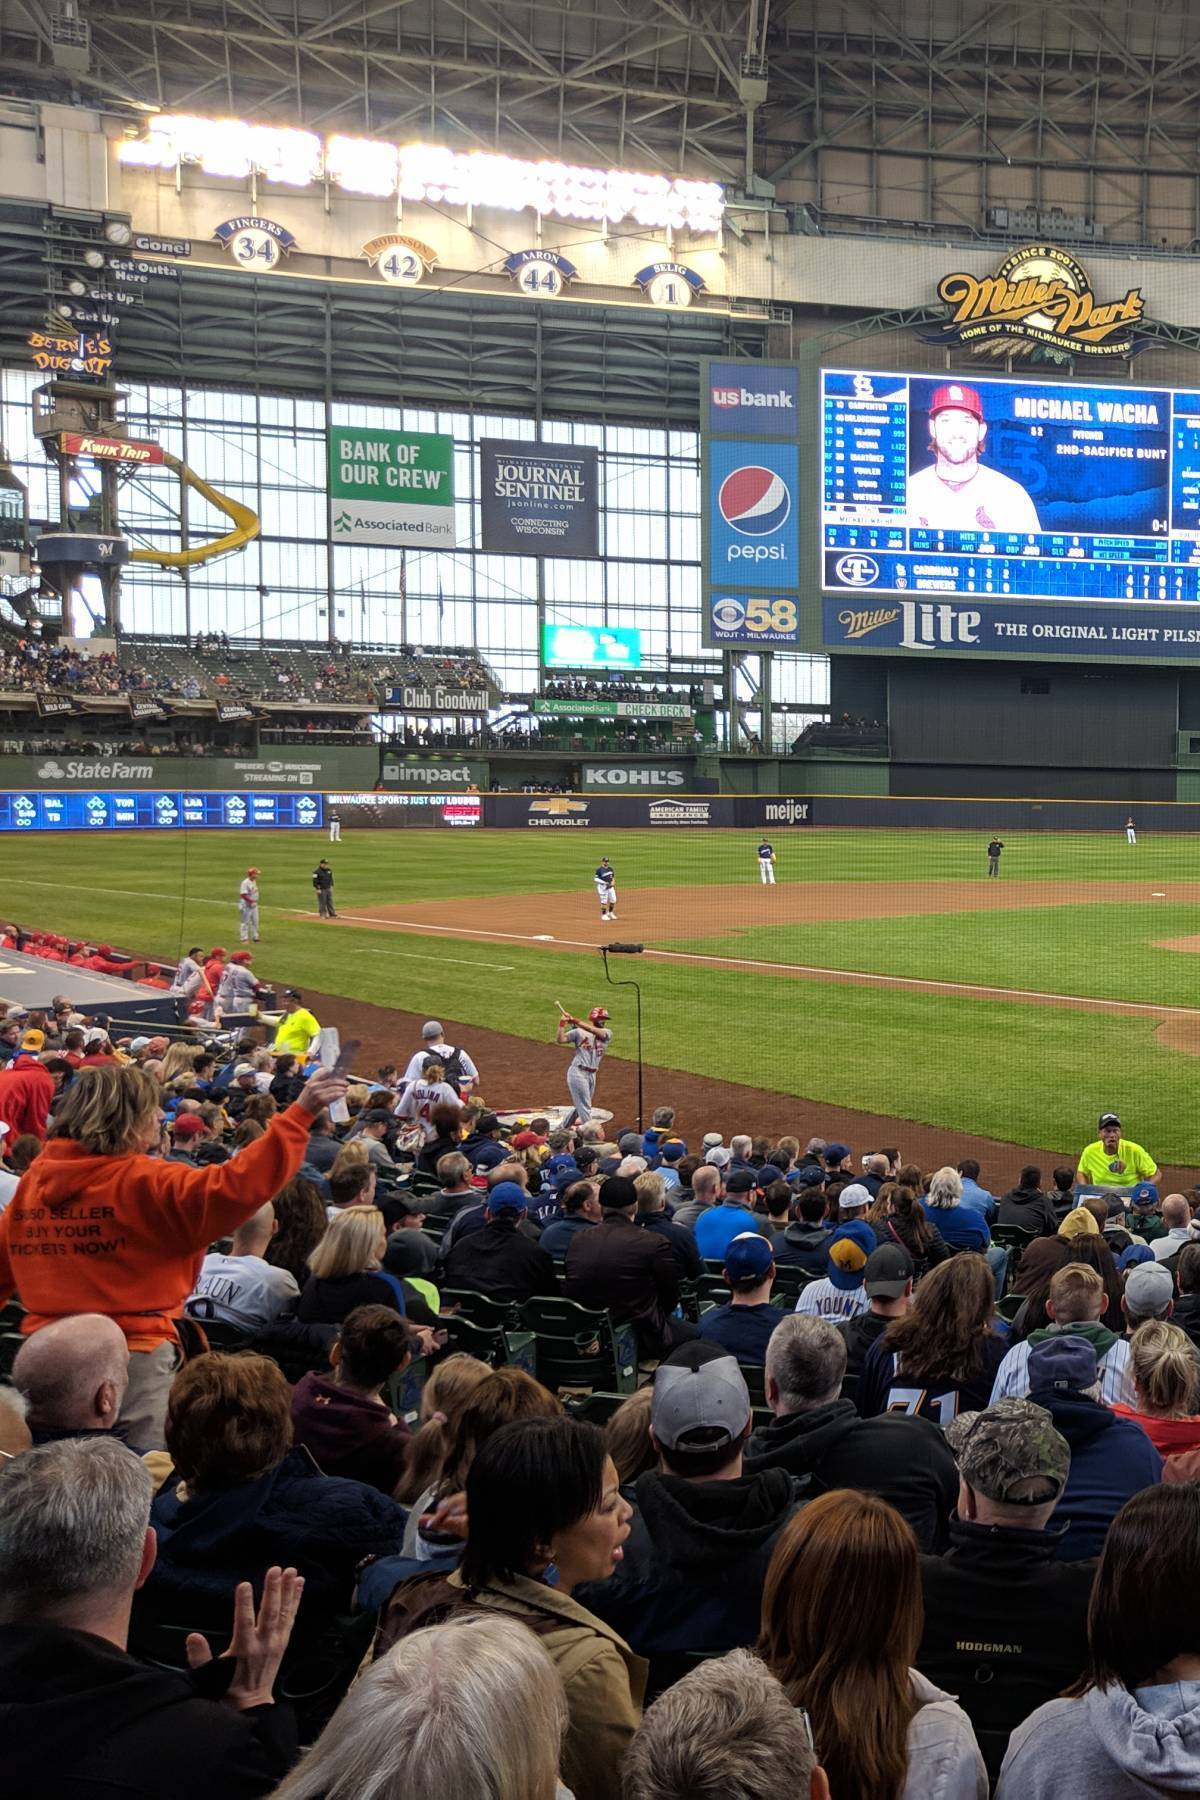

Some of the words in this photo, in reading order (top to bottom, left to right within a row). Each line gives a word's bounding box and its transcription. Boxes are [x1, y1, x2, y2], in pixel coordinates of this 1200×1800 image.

[228, 219, 283, 236] FINGERS
[136, 238, 191, 255] Gone!
[238, 237, 275, 263] 34
[371, 233, 431, 254] ROBINSON
[383, 254, 419, 278] 42
[521, 251, 560, 264] AARON
[1010, 247, 1046, 265] SINCE
[1050, 250, 1075, 268] 2001
[110, 259, 132, 272] Get
[138, 262, 177, 277] Outta
[115, 271, 148, 283] Here
[653, 264, 688, 276] SELIG
[523, 269, 557, 291] 44
[90, 290, 114, 301] Get
[116, 292, 135, 305] Up
[665, 283, 677, 304] 1
[939, 273, 1068, 324] Miller
[1042, 288, 1146, 335] Park
[75, 311, 99, 322] Get
[100, 313, 120, 326] Up
[959, 326, 988, 341] HOME
[989, 323, 1003, 333] OF
[1005, 324, 1025, 335] THE
[1026, 328, 1082, 351] MILWAUKEE
[1084, 341, 1131, 354] BREWERS
[1014, 397, 1093, 422] MICHAEL
[1097, 401, 1159, 425] WACHA
[339, 439, 391, 463] BANK
[396, 444, 420, 465] OF
[1056, 444, 1134, 458] 2ND-SACIFICE
[1136, 448, 1167, 460] BUNT
[340, 464, 380, 486] OUR
[495, 464, 585, 486] JOURNAL
[494, 481, 586, 502] SENTINEL
[507, 499, 575, 511] jsonline.com
[510, 517, 569, 529] CONNECTING
[515, 526, 566, 536] WISCONSIN
[727, 543, 786, 563] pepsi
[744, 598, 798, 633] 58
[715, 630, 740, 639] WDJT
[746, 631, 797, 640] MILWAUKEE
[838, 607, 901, 639] Miller
[899, 601, 982, 650] Lite
[994, 622, 1028, 637] THE
[1032, 623, 1108, 641] ORIGINAL
[1111, 626, 1160, 642] LIGHT
[403, 688, 433, 709] Club
[435, 689, 489, 711] Goodwill
[625, 704, 657, 716] CHECK
[660, 705, 685, 717] DECK
[244, 773, 287, 783] STREAMING
[287, 774, 298, 783] ON
[400, 763, 471, 785] impact
[586, 769, 685, 786] KOHL'S
[328, 795, 377, 805] MILWAUKEE
[377, 796, 409, 805] SPORTS
[410, 796, 429, 805] JUST
[430, 796, 445, 806] GOT
[446, 796, 480, 806] LOUDER
[765, 799, 809, 824] meijer
[528, 818, 590, 826] CHEVROLET
[50, 1206, 115, 1220] SELLER
[55, 1224, 101, 1238] YOUR
[10, 1243, 67, 1256] TICKETS
[74, 1237, 127, 1255] NOW!
[816, 1296, 864, 1318] YOUNT
[886, 1387, 960, 1425] 71
[956, 1641, 1023, 1654] HODGMAN
